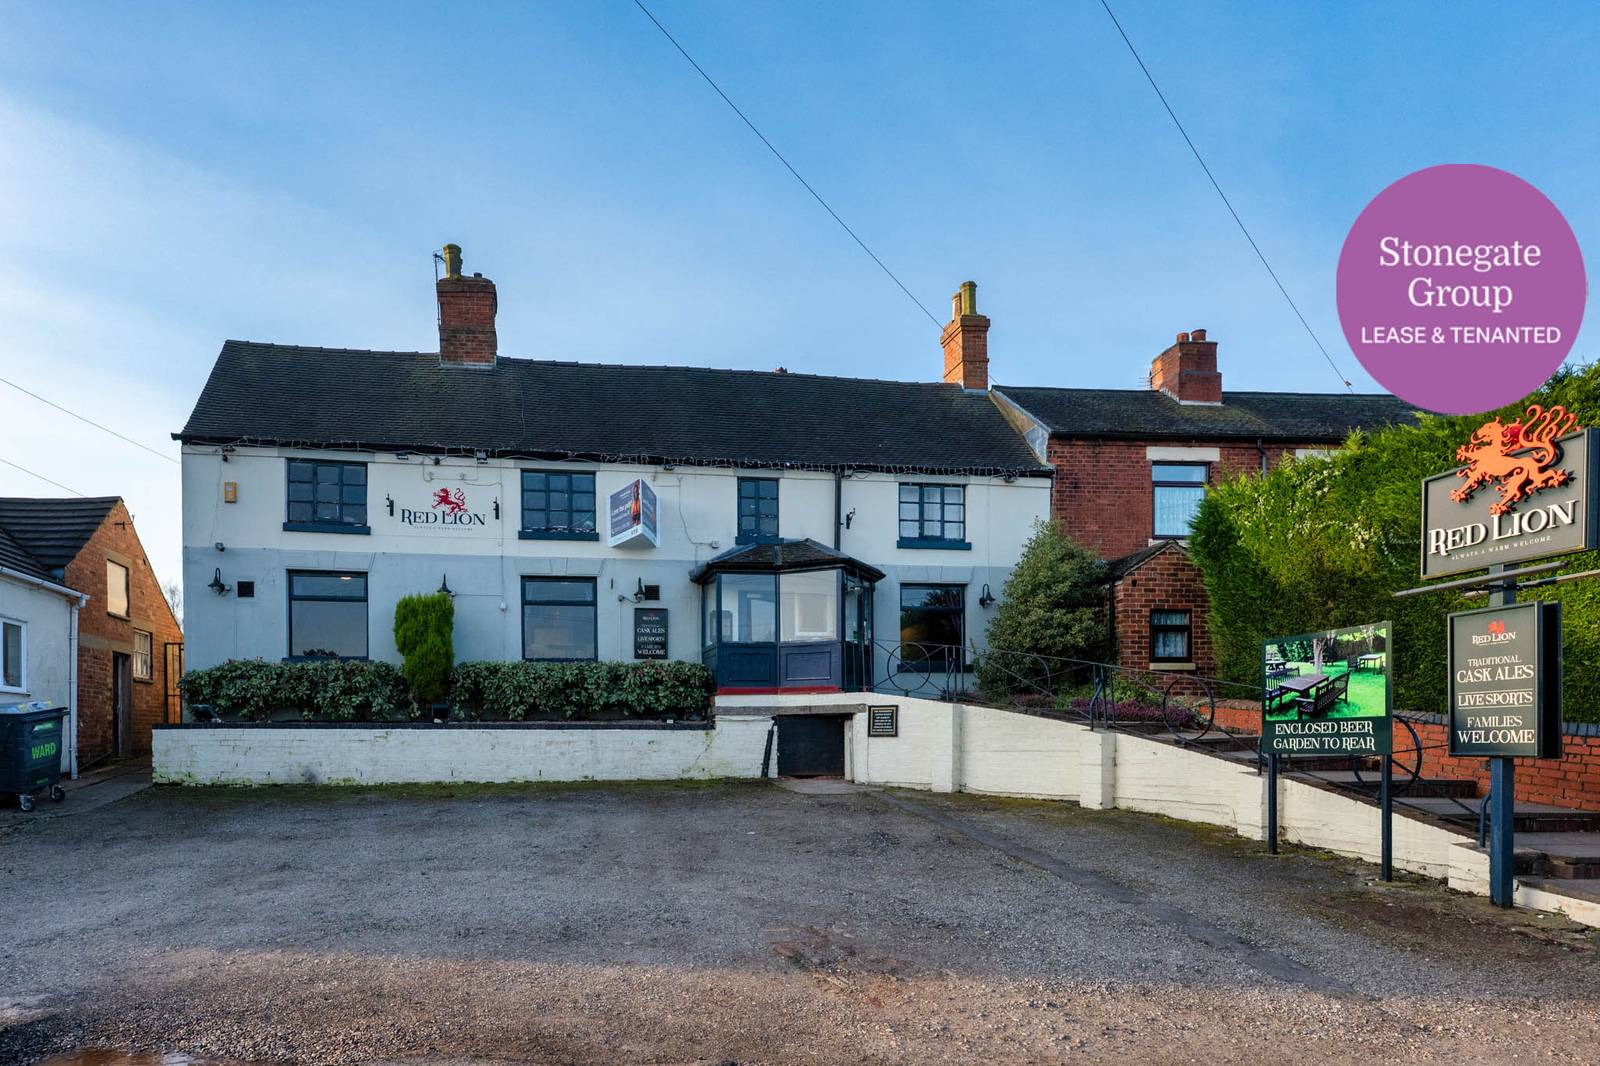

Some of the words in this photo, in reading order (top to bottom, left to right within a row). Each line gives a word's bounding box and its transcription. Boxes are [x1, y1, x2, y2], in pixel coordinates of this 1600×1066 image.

[401, 508, 438, 526] RED
[441, 510, 486, 526] LION
[1428, 522, 1488, 556] RED
[1491, 499, 1580, 541] LION
[1488, 544, 1510, 553] WARM
[1513, 535, 1552, 548] WELCOME
[1472, 635, 1491, 645] RED
[1492, 631, 1517, 642] LION
[1467, 655, 1522, 668] TRADITIONAL
[1456, 668, 1493, 683] CASK
[1495, 665, 1534, 681] ALES
[1458, 694, 1485, 707] LIVE
[1486, 691, 1534, 706] SPORTS
[1275, 722, 1338, 735] ENCLOSED
[1340, 721, 1374, 735] BEER
[1467, 715, 1523, 728] FAMILIES
[1273, 738, 1320, 751] GARDEN
[1322, 739, 1340, 749] TO
[1342, 737, 1376, 751] REAR
[1457, 729, 1535, 744] WELCOME
[31, 742, 57, 760] WARD
